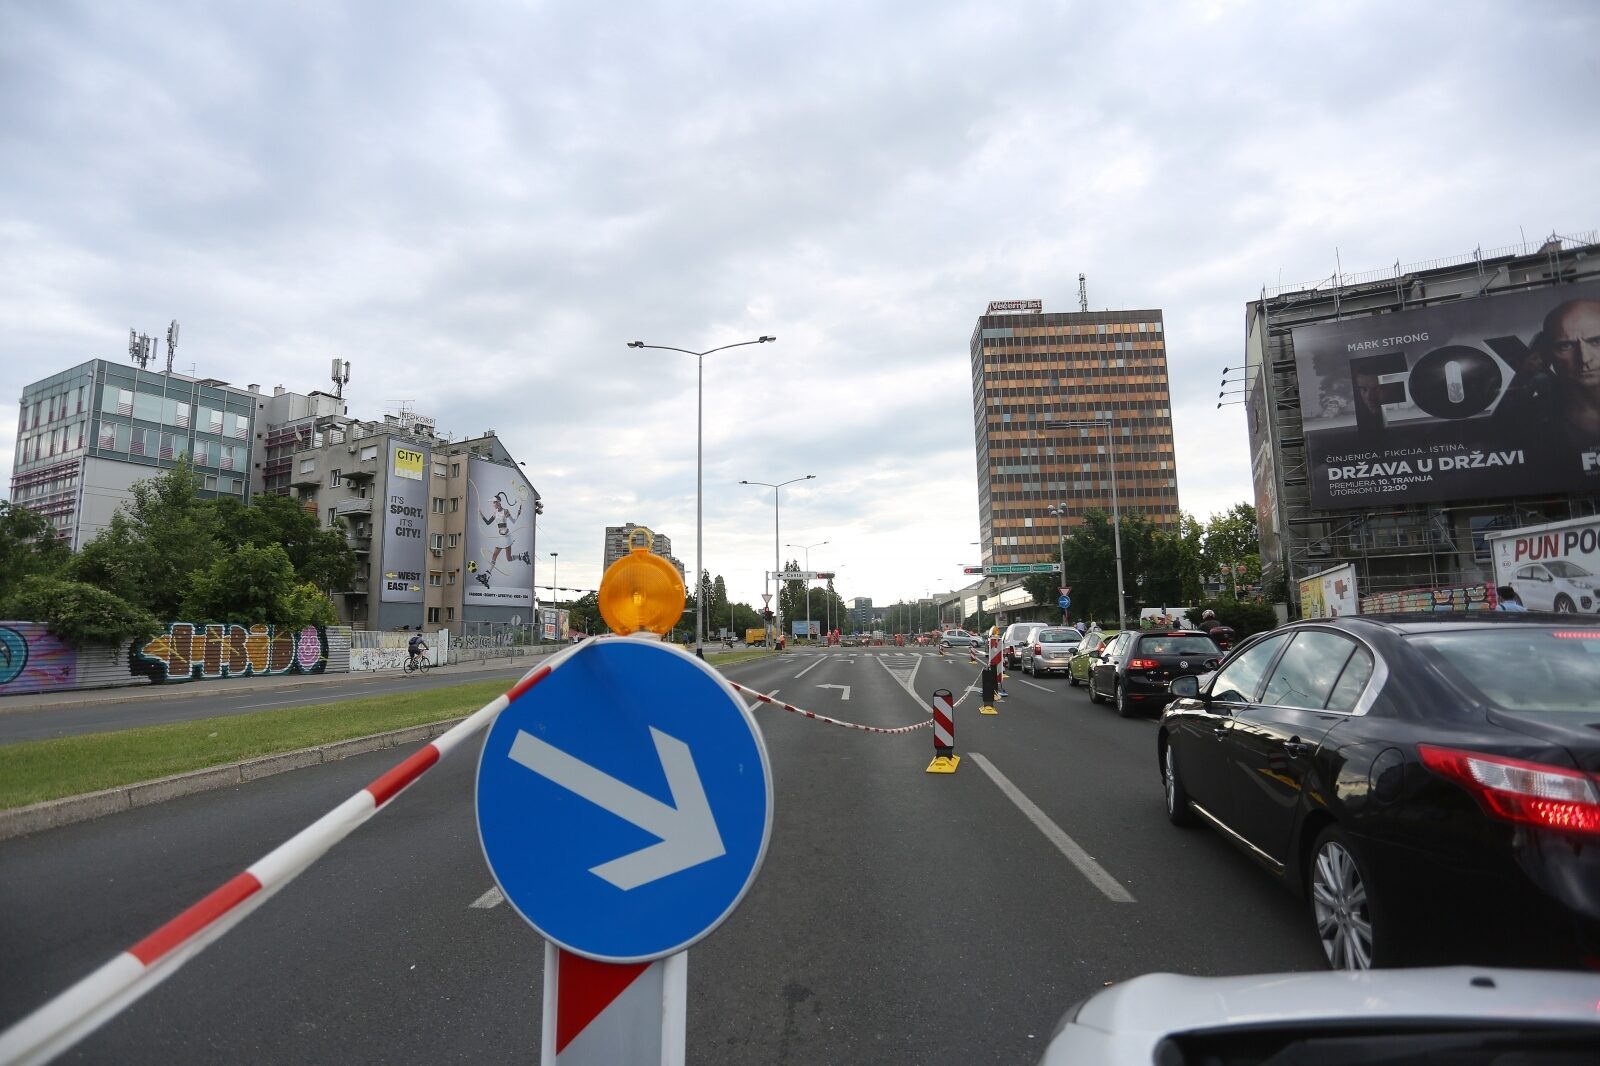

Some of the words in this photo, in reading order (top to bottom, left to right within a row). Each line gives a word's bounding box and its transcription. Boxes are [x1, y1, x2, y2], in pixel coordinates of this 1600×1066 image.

[1347, 339, 1379, 352] MARK
[1382, 332, 1429, 347] STRONG
[397, 450, 422, 463] CITY
[1326, 451, 1381, 463] ČINJENICA.
[1384, 447, 1426, 458] FIKCIJA.
[1429, 442, 1468, 453] ISTINA.
[1327, 461, 1413, 481] DRŽAVA
[1417, 458, 1433, 472] U
[1438, 450, 1525, 471] DRŽAVI
[1329, 479, 1377, 490] PREMIJERA
[1378, 477, 1390, 486] 10.
[1391, 474, 1433, 485] TRAVNJA
[1330, 486, 1373, 497] UTORKOM
[1375, 485, 1381, 493] U
[1382, 483, 1407, 492] 22:00
[391, 495, 404, 505] IT'S
[390, 504, 424, 519] SPORT,
[395, 526, 421, 539] CITY!
[1515, 532, 1559, 562] PUN
[1563, 527, 1600, 557] PO
[398, 571, 421, 581] WEST
[387, 581, 409, 591] EAST
